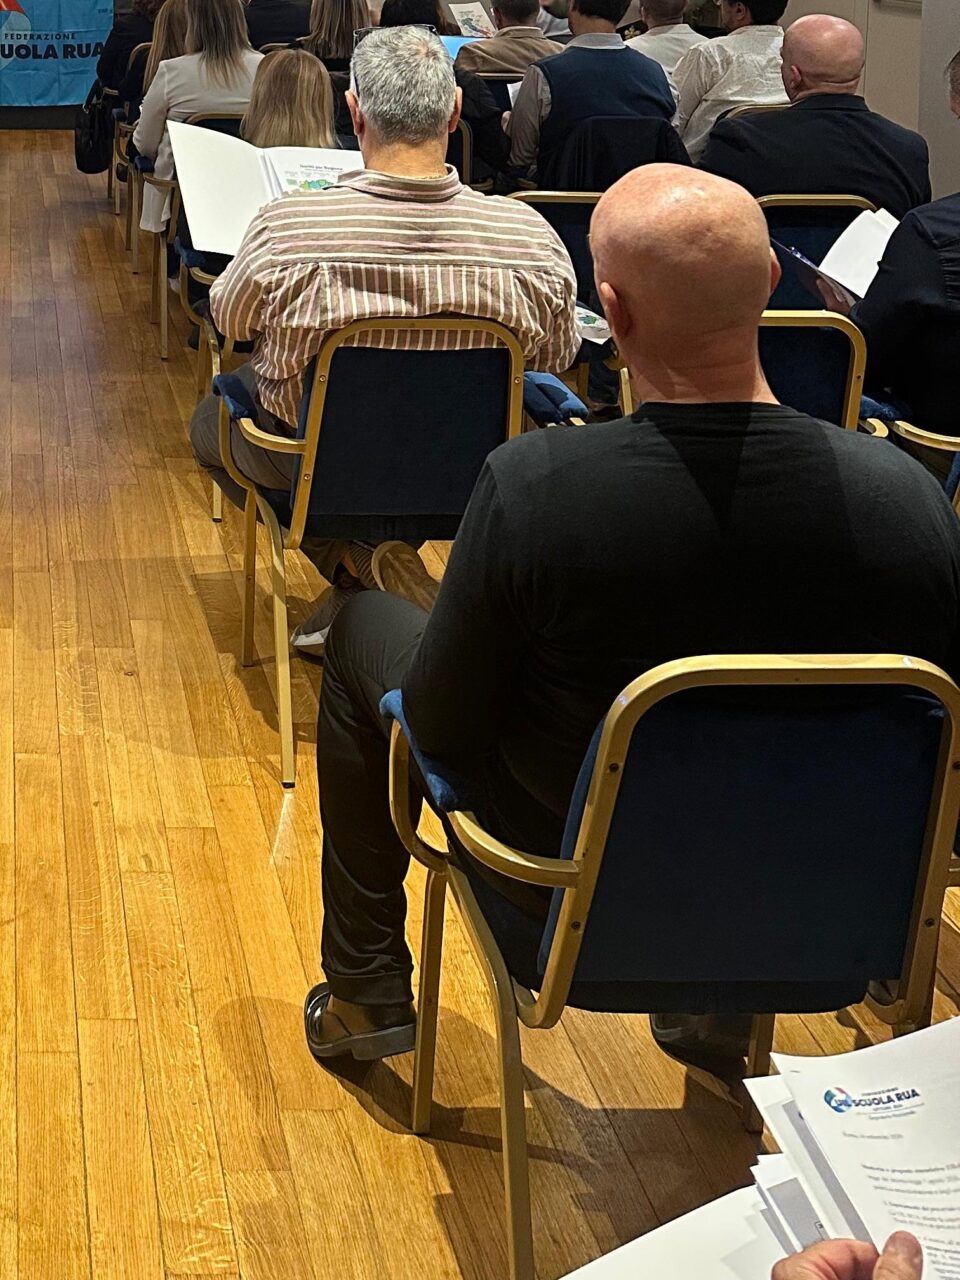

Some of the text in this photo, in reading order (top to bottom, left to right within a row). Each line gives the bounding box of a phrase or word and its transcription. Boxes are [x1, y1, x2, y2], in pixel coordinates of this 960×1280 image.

[4, 32, 76, 41] FEDERAZIONE
[63, 41, 104, 59] RUA
[853, 1095, 895, 1107] SCUOLA
[895, 1088, 921, 1102] RUA
